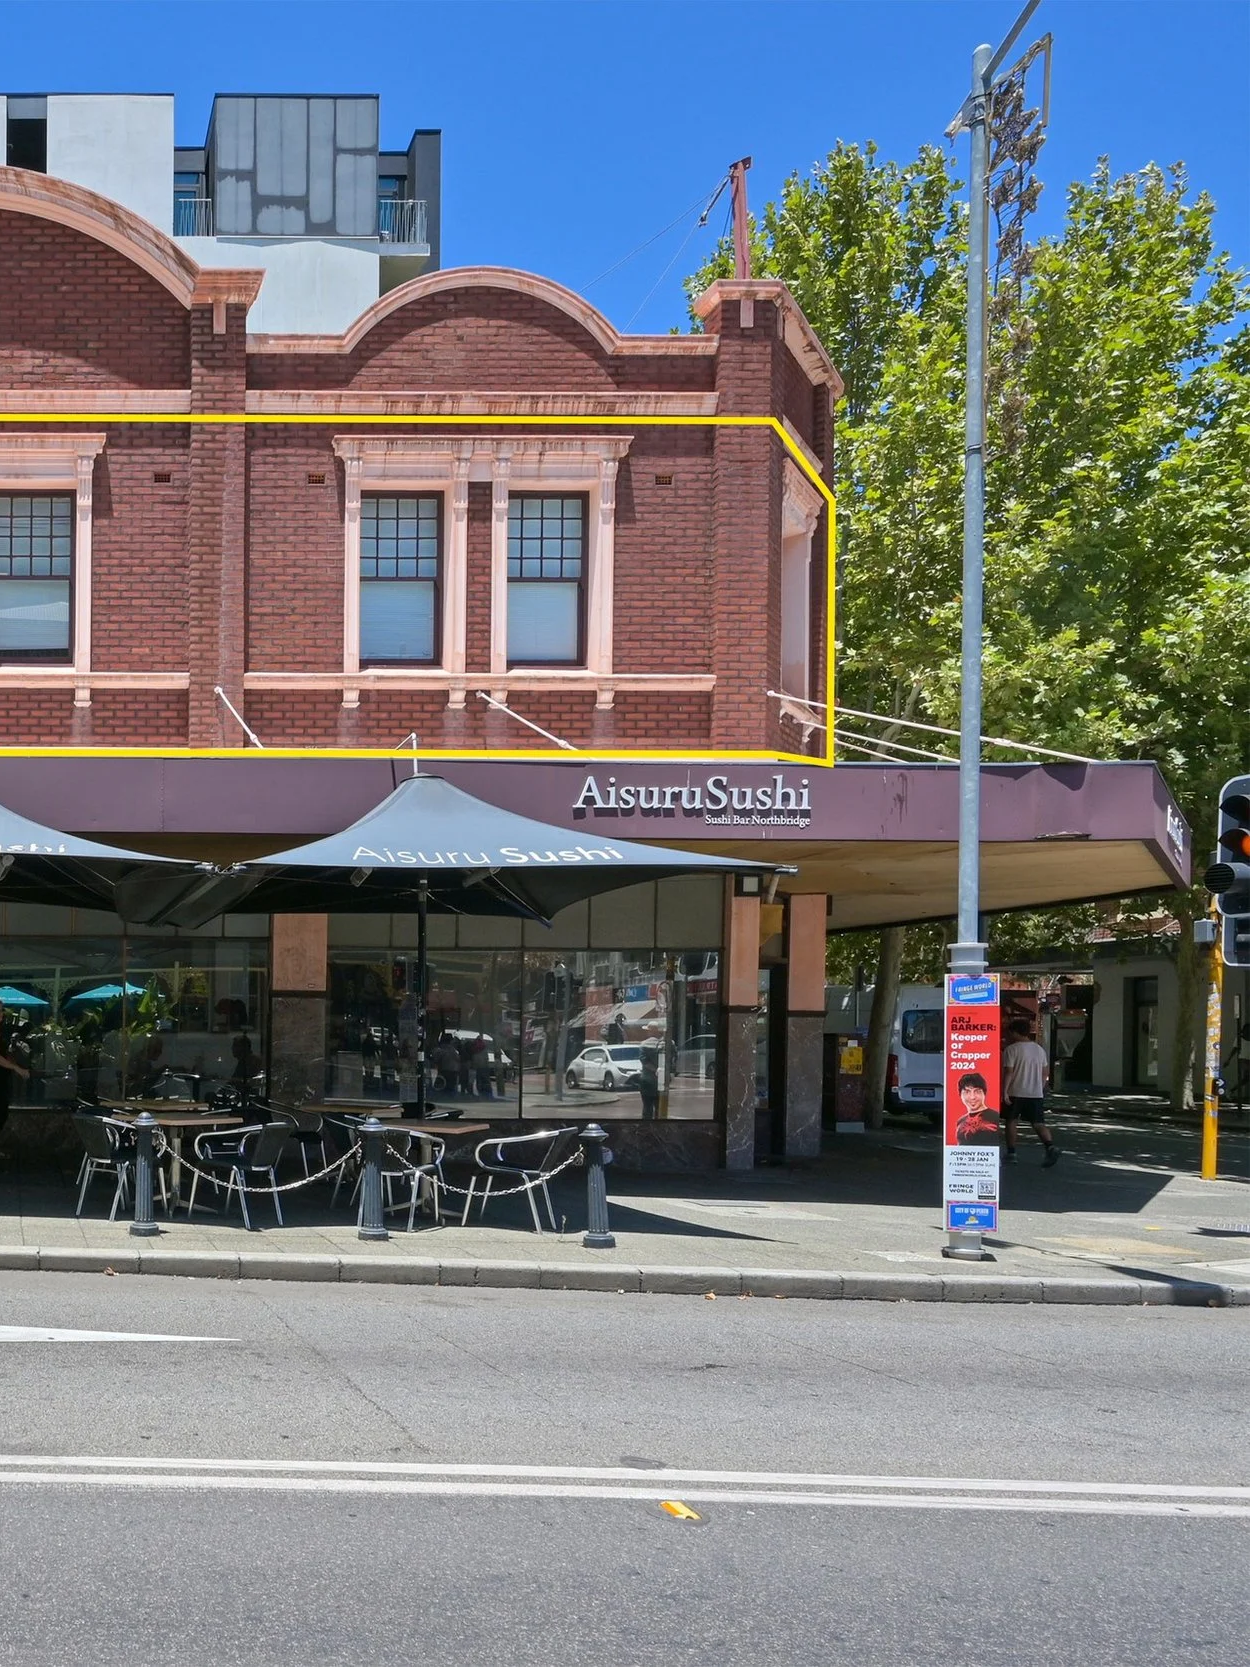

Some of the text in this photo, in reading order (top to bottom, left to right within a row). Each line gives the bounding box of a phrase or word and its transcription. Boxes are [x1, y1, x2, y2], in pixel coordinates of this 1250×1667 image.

[705, 814, 811, 828] Sushi Bar Northbridge
[352, 846, 623, 864] Aisuru Sushi
[951, 1016, 971, 1024] ARJ
[951, 1033, 988, 1043] Keeper
[951, 1051, 991, 1061] Crapper
[951, 1062, 976, 1070] 2024
